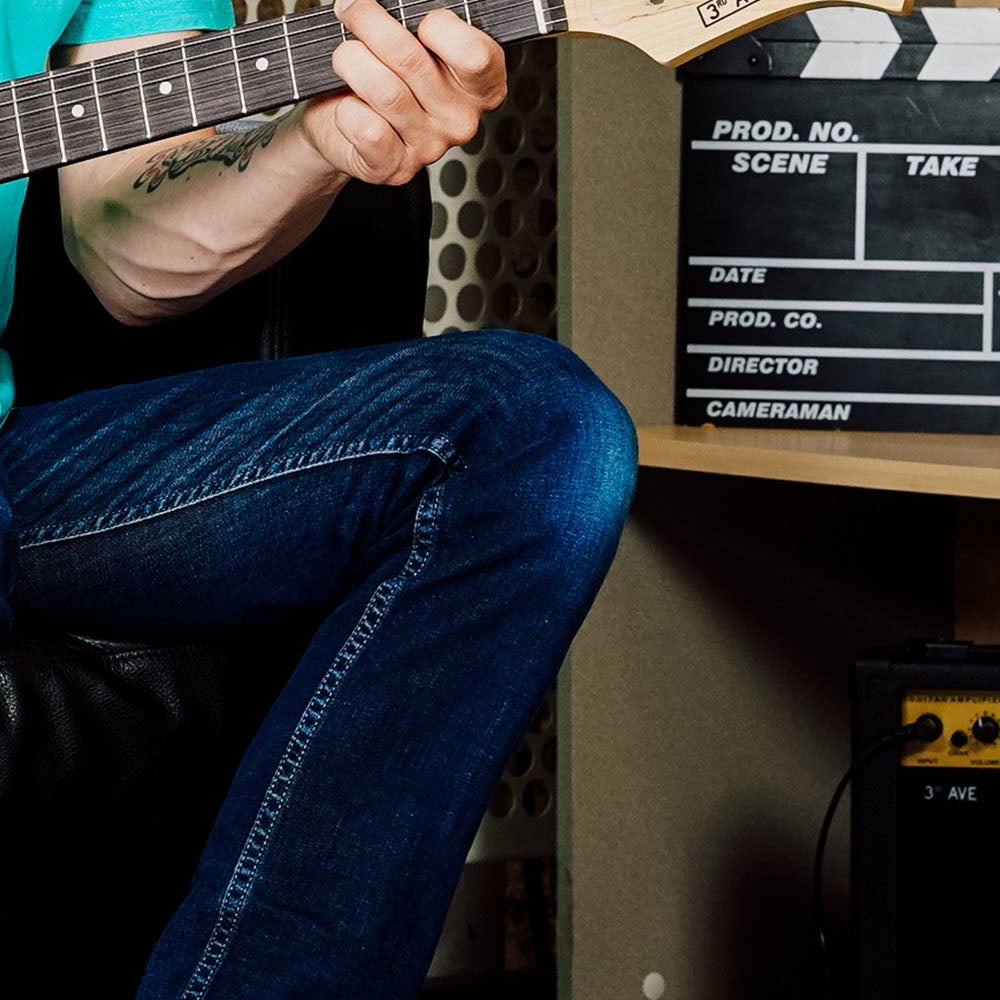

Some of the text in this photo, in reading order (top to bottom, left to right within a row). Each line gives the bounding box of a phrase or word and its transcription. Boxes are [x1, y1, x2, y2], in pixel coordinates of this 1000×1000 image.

[712, 120, 860, 142] PROD. NO.
[731, 152, 830, 175] SCENE
[906, 155, 979, 177] TAKE
[709, 267, 767, 284] DATE
[708, 310, 823, 329] PROD. CO.
[707, 356, 819, 376] DIRECTOR
[706, 401, 851, 421] CAMERAMAN
[947, 786, 977, 801] AVE
